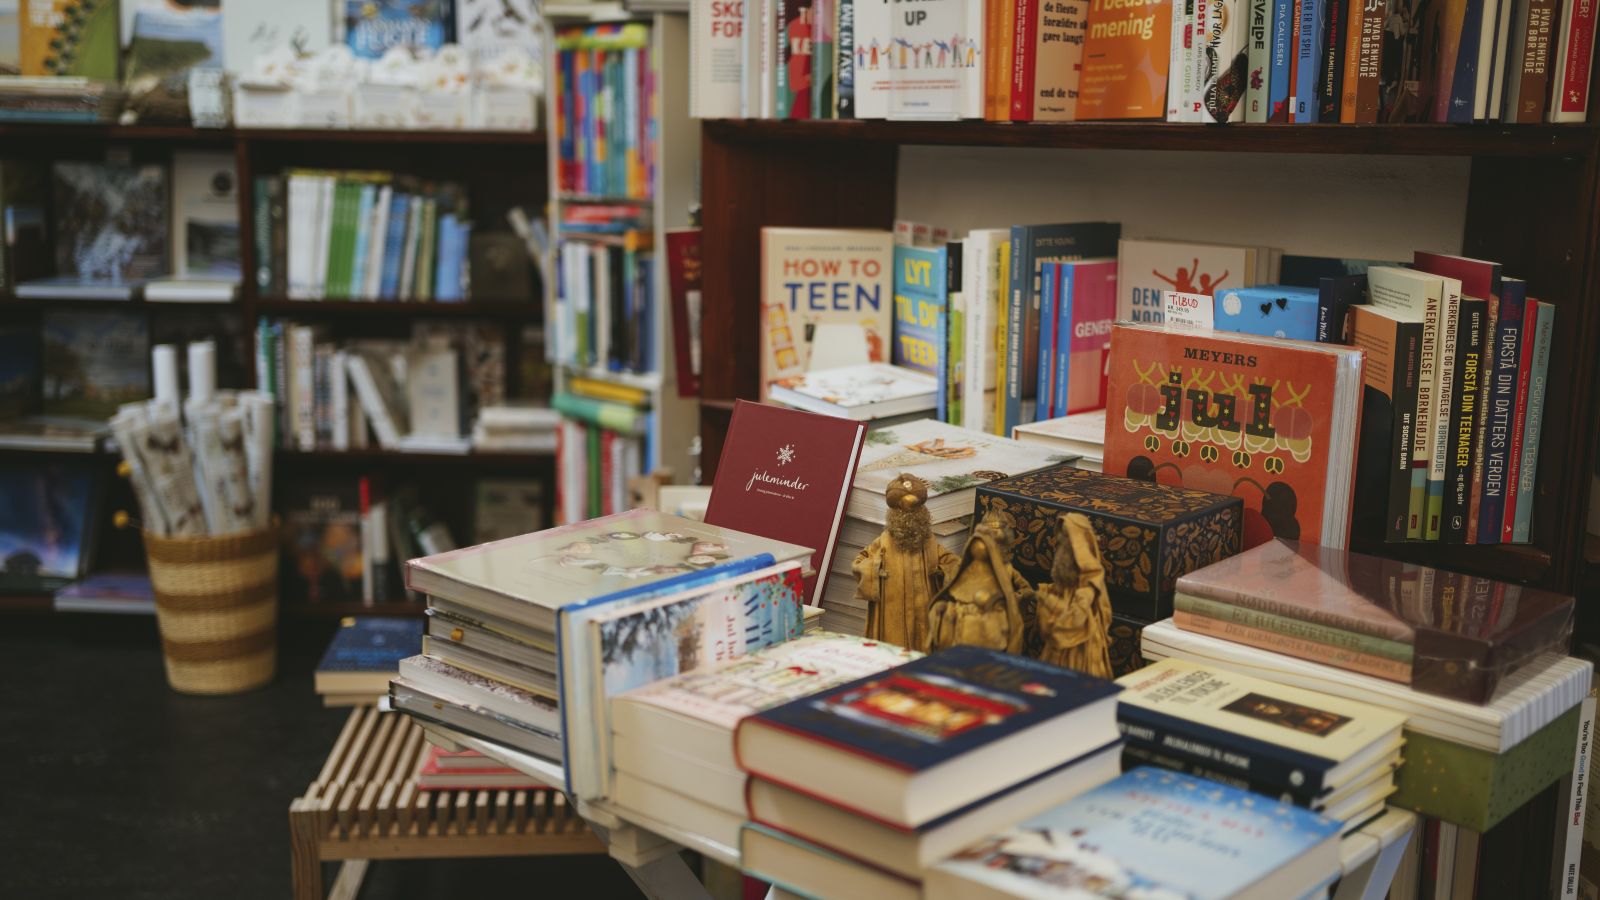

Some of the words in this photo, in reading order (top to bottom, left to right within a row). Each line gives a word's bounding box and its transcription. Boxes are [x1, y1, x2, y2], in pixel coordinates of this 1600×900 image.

[904, 10, 927, 27] UP
[1279, 4, 1287, 19] PIA
[1293, 5, 1301, 37] GAMING
[1303, 13, 1312, 23] ER
[1530, 8, 1541, 26] FAR
[1539, 8, 1551, 33] HVAD
[1091, 13, 1155, 40] mening
[1209, 23, 1222, 48] HVOR
[1302, 24, 1312, 36] DIT
[1363, 18, 1372, 34] FAR
[1371, 17, 1382, 40] HVAD
[1276, 21, 1286, 66] CALLESEN
[1368, 43, 1380, 78] ENHVER
[1524, 51, 1535, 73] VIDE
[1535, 36, 1548, 74] ENHVER
[1326, 51, 1335, 97] FAMILIELIVET
[1359, 57, 1370, 78] VIDE
[784, 259, 842, 277] HOW
[848, 259, 881, 277] TO
[904, 258, 932, 288] LYT
[784, 282, 880, 312] TEEN
[1132, 287, 1160, 307] DEN
[895, 294, 917, 325] TIL
[1471, 312, 1480, 329] GITTE
[1445, 294, 1458, 353] ANERKENDELSE
[1421, 297, 1437, 375] ANERKENDELSE
[1470, 330, 1479, 346] HAAG
[1486, 314, 1497, 359] Frederiksen
[1184, 348, 1258, 368] MEYERS
[1499, 328, 1517, 369] FORSTÅ
[1444, 356, 1453, 366] OG
[1463, 353, 1478, 392] FORSTÅ
[1484, 370, 1492, 385] Den
[1439, 368, 1452, 418] IAGTTAGELSE
[1496, 374, 1512, 394] DIN
[1156, 371, 1276, 438] jul
[1461, 395, 1474, 412] DIN
[1403, 413, 1411, 423] DIT
[1415, 387, 1430, 452] BØRNEHØJDE
[1491, 399, 1509, 448] DATTERS
[1530, 406, 1540, 425] IKKE
[1400, 425, 1410, 451] SOCIALE
[1456, 414, 1472, 467] TEENAGER
[1528, 427, 1537, 444] DIN
[1434, 425, 1447, 473] BØRNEHØJDE
[1399, 452, 1408, 470] BARN
[1523, 445, 1537, 494] TEENAGER
[745, 468, 809, 492] juleminder
[1486, 452, 1504, 496] VERDEN
[1456, 482, 1464, 492] dig
[1582, 720, 1591, 741] You're
[1580, 742, 1588, 754] Too
[1578, 755, 1587, 773] Good
[1575, 782, 1584, 797] Feel
[1574, 798, 1583, 811] This
[1573, 812, 1581, 826] Bad
